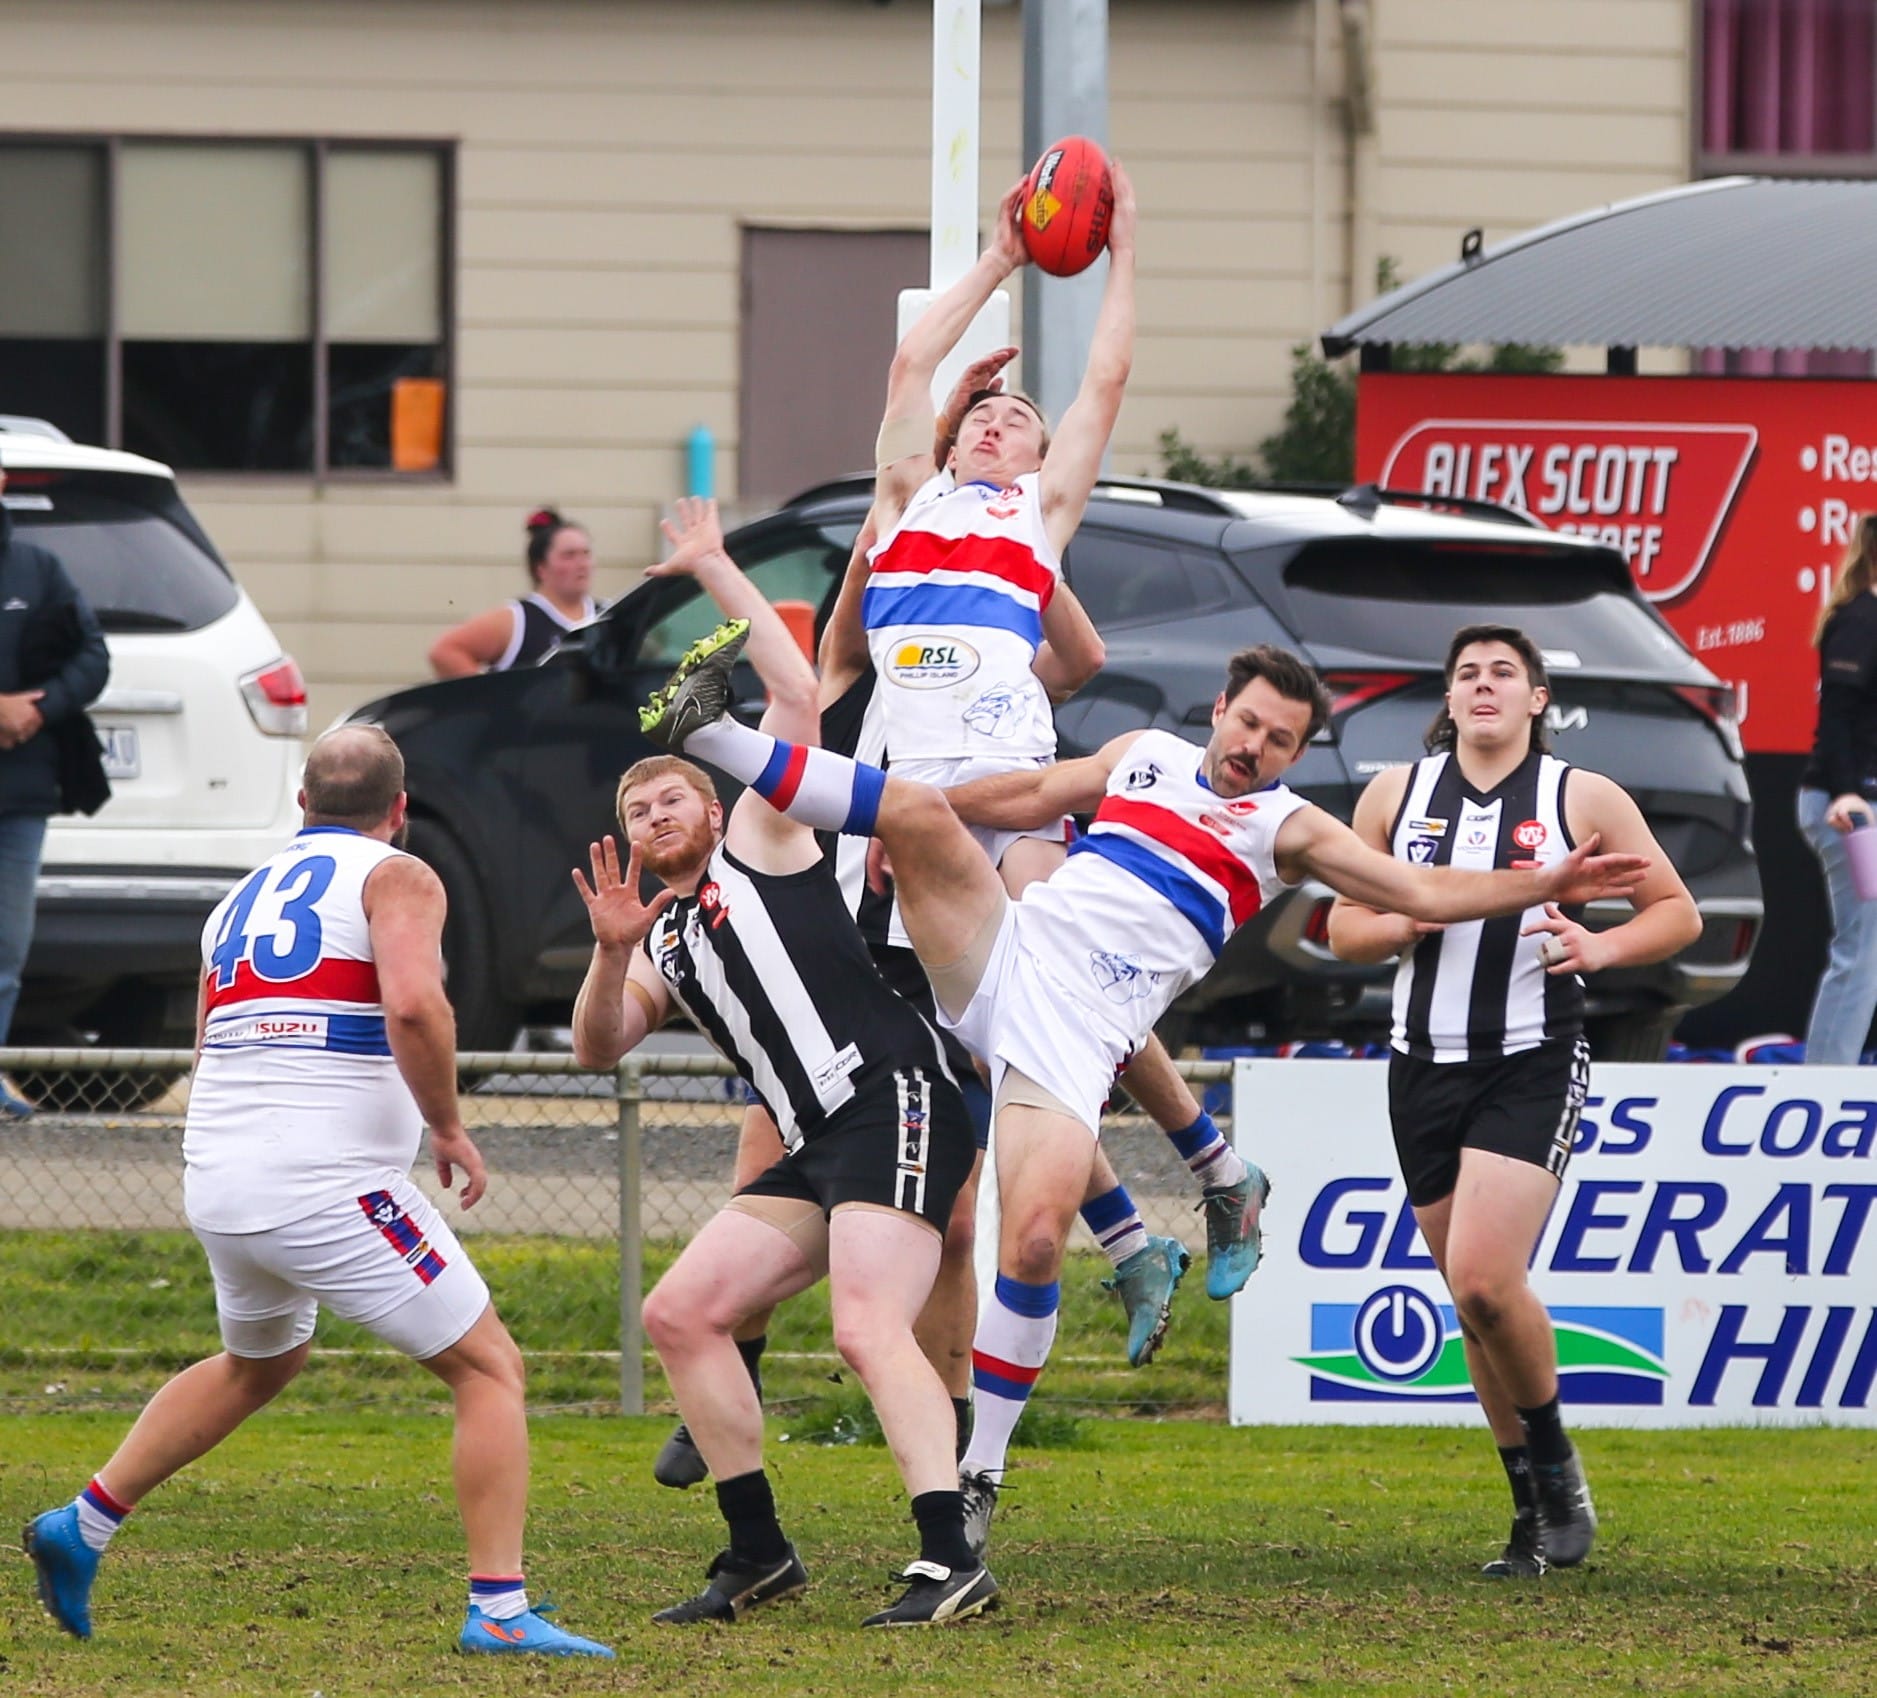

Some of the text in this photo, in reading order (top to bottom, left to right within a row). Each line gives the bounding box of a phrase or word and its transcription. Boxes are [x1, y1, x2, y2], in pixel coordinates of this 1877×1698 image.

[1539, 444, 1678, 515] SCOTT
[1820, 497, 1859, 546] R
[919, 646, 958, 664] RSL
[211, 854, 337, 987] 43
[255, 1022, 318, 1035] ISUZU
[1573, 1085, 1877, 1158] ss Coa
[1298, 1177, 1877, 1276] GERAT
